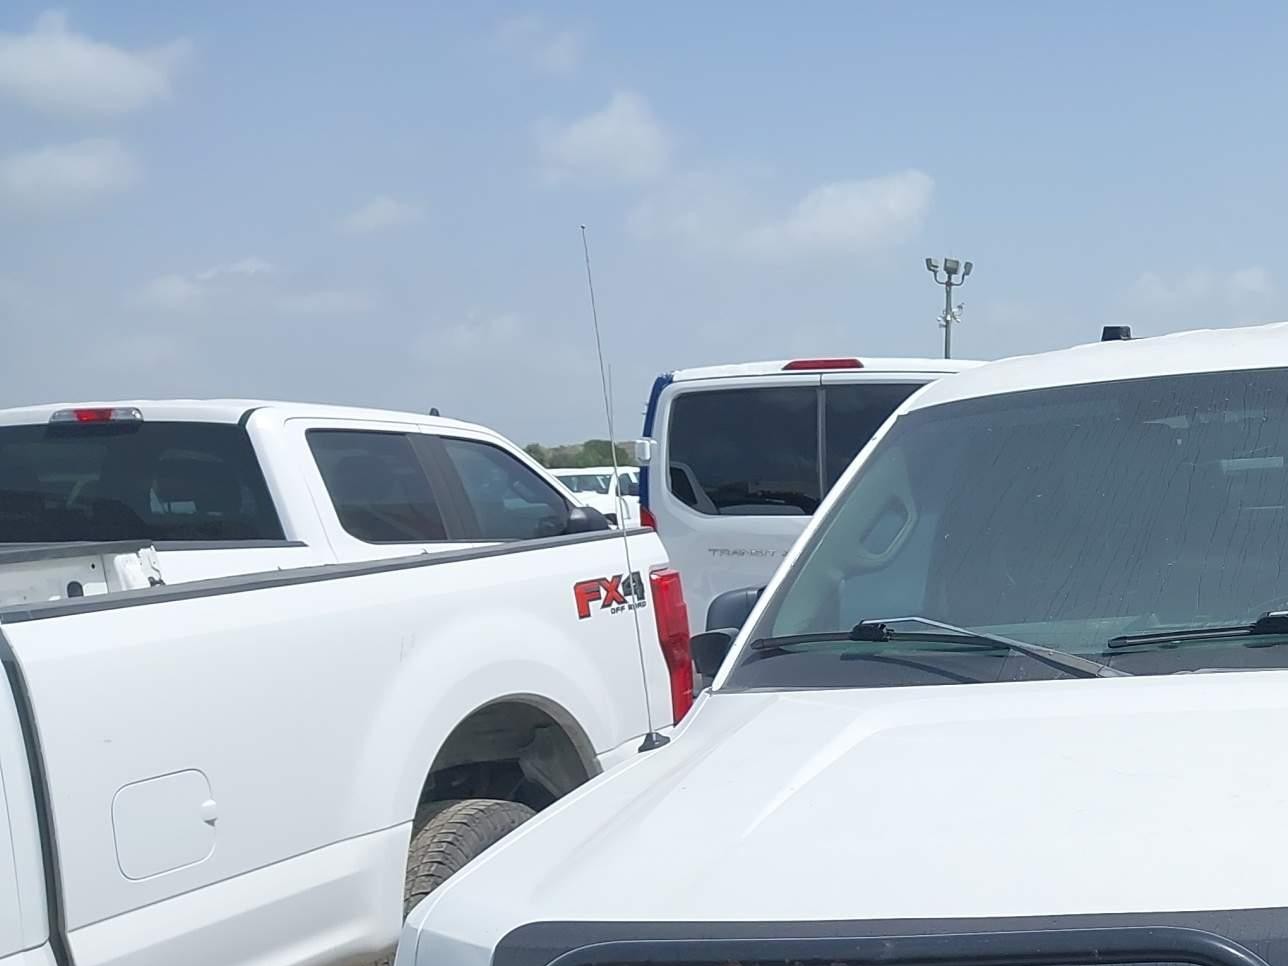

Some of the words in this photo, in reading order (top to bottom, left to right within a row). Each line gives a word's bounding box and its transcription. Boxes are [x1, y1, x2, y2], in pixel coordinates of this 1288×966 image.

[708, 548, 777, 557] TRANSIT
[574, 571, 646, 619] FX4
[611, 605, 626, 614] OFF
